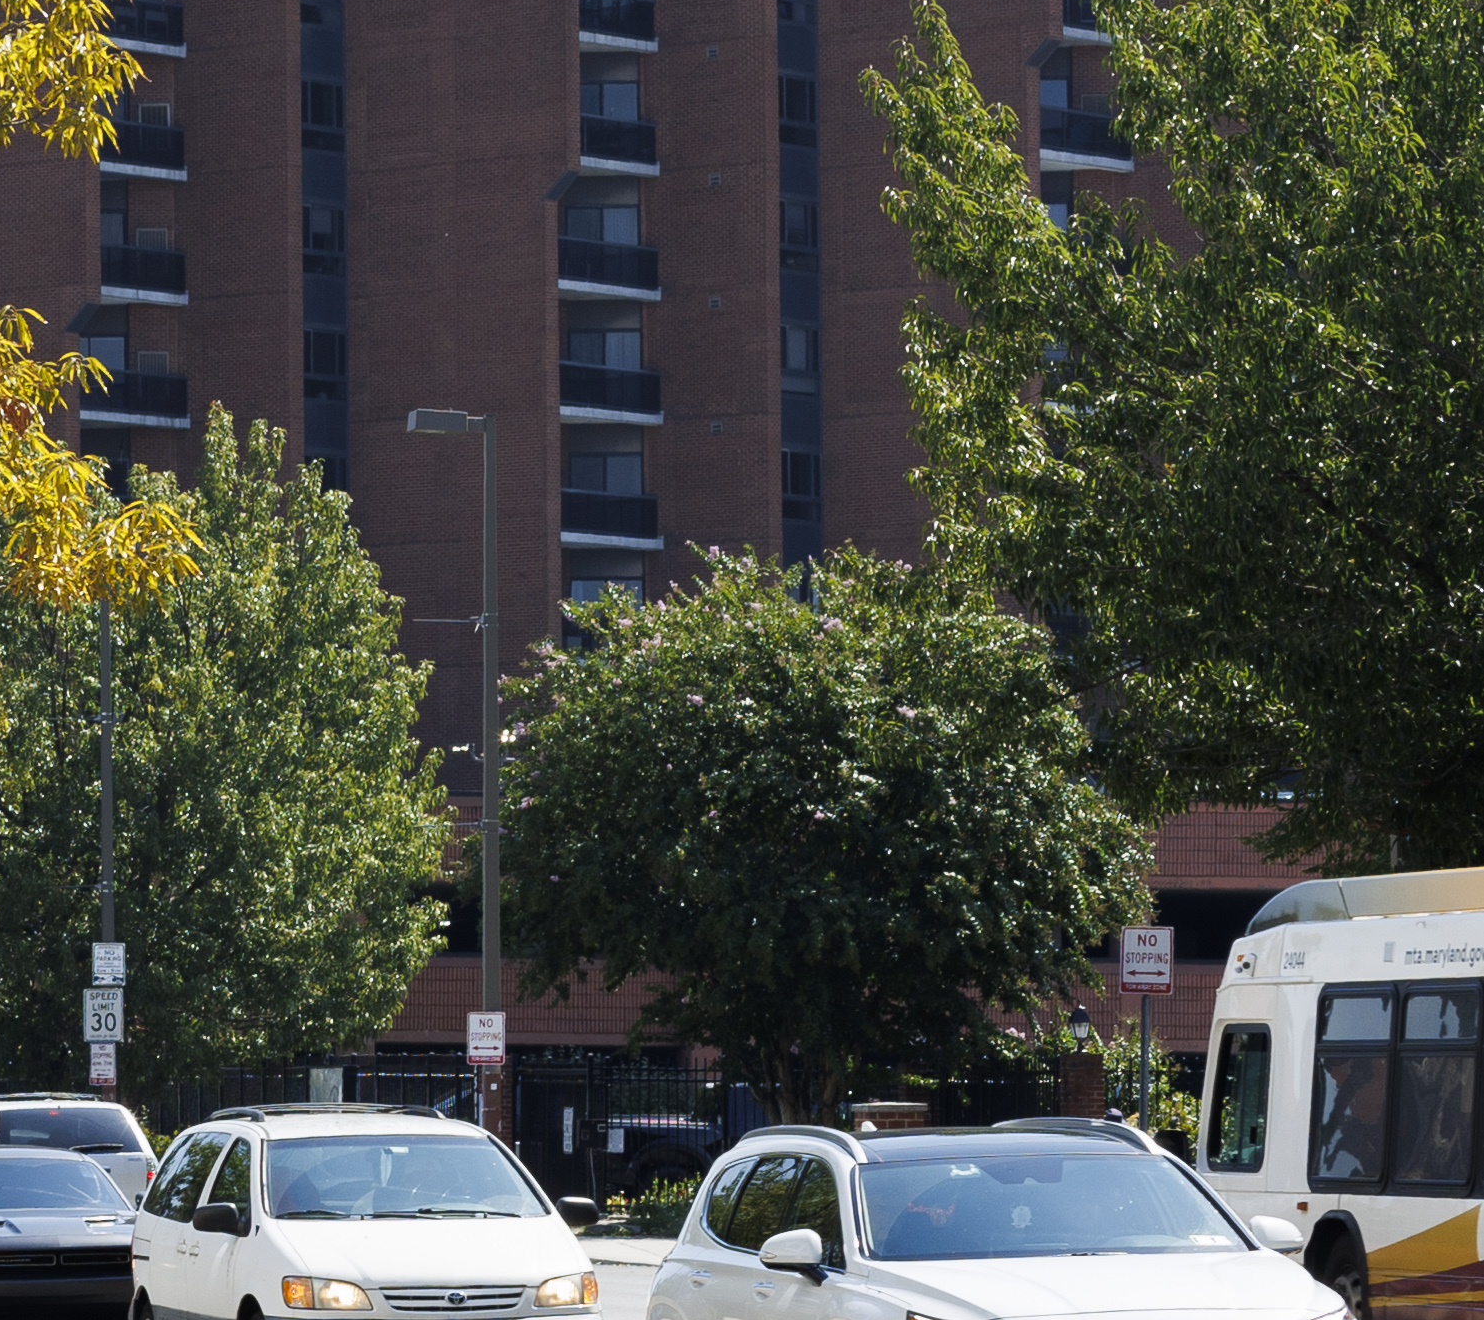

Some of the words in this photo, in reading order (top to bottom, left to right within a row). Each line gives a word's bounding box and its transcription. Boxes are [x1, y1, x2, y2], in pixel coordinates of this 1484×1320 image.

[1137, 934, 1158, 947] NO
[1125, 952, 1169, 964] STOPPING
[90, 992, 118, 1001] SPEED
[92, 1003, 115, 1011] LIMIT
[91, 1012, 117, 1032] 30
[479, 1018, 494, 1028] NO
